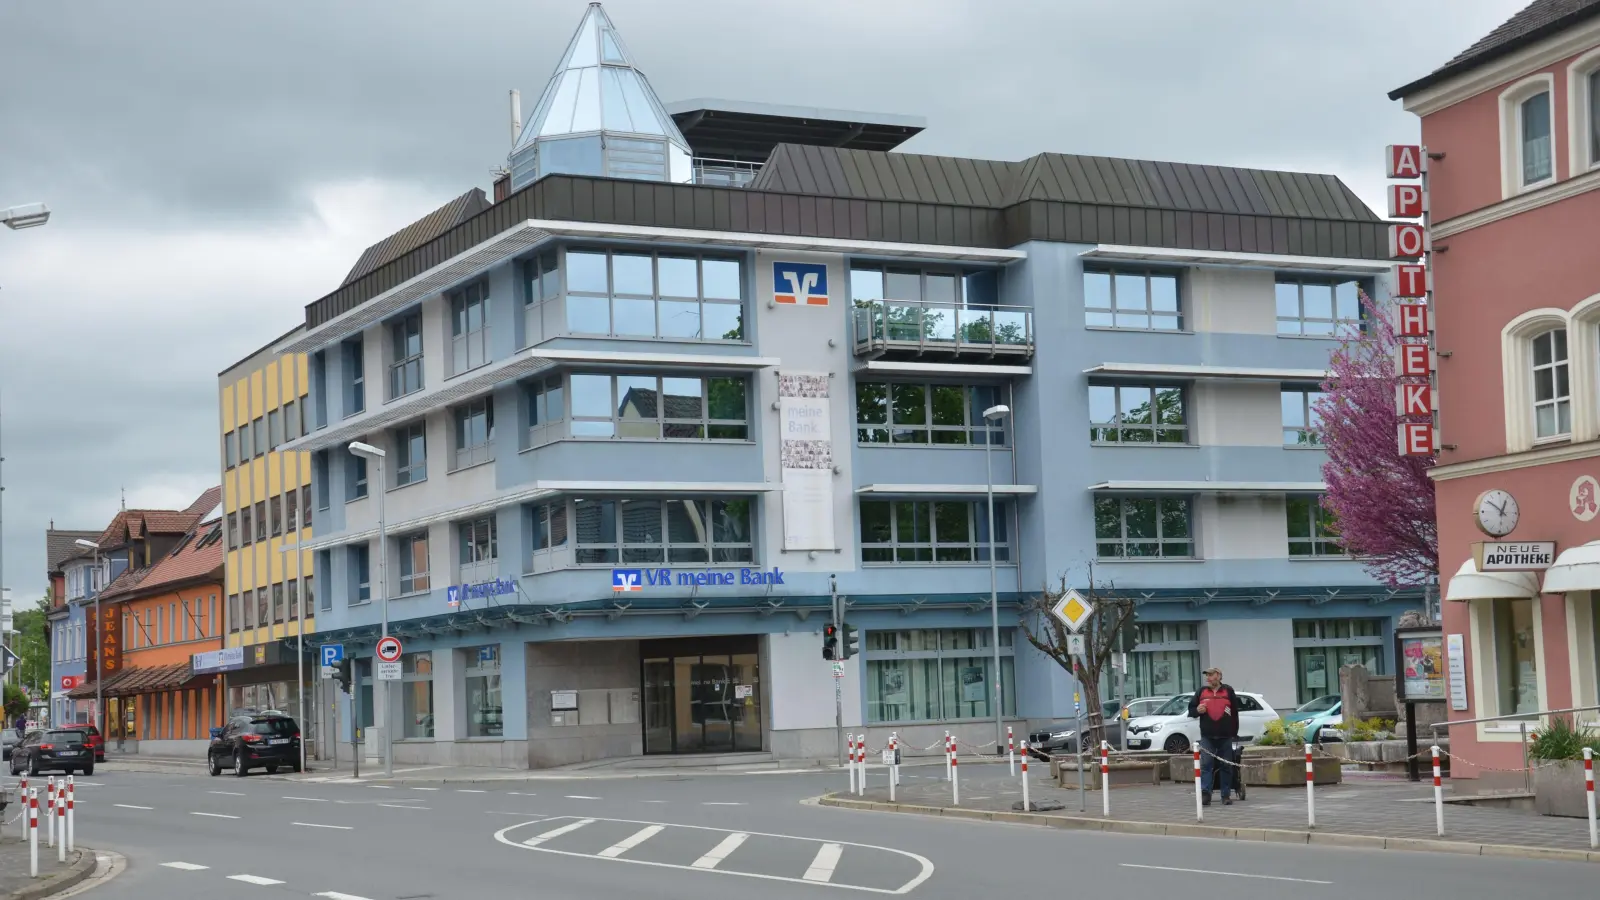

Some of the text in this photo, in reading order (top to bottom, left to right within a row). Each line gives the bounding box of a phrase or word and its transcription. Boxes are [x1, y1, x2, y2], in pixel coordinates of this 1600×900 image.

[1396, 146, 1430, 453] APOTHEKE
[1496, 544, 1541, 553] NEUE
[1486, 553, 1551, 565] APOTHEKE
[645, 566, 785, 586] VR meine Bank
[103, 607, 117, 670] JEANS
[324, 647, 337, 665] P
